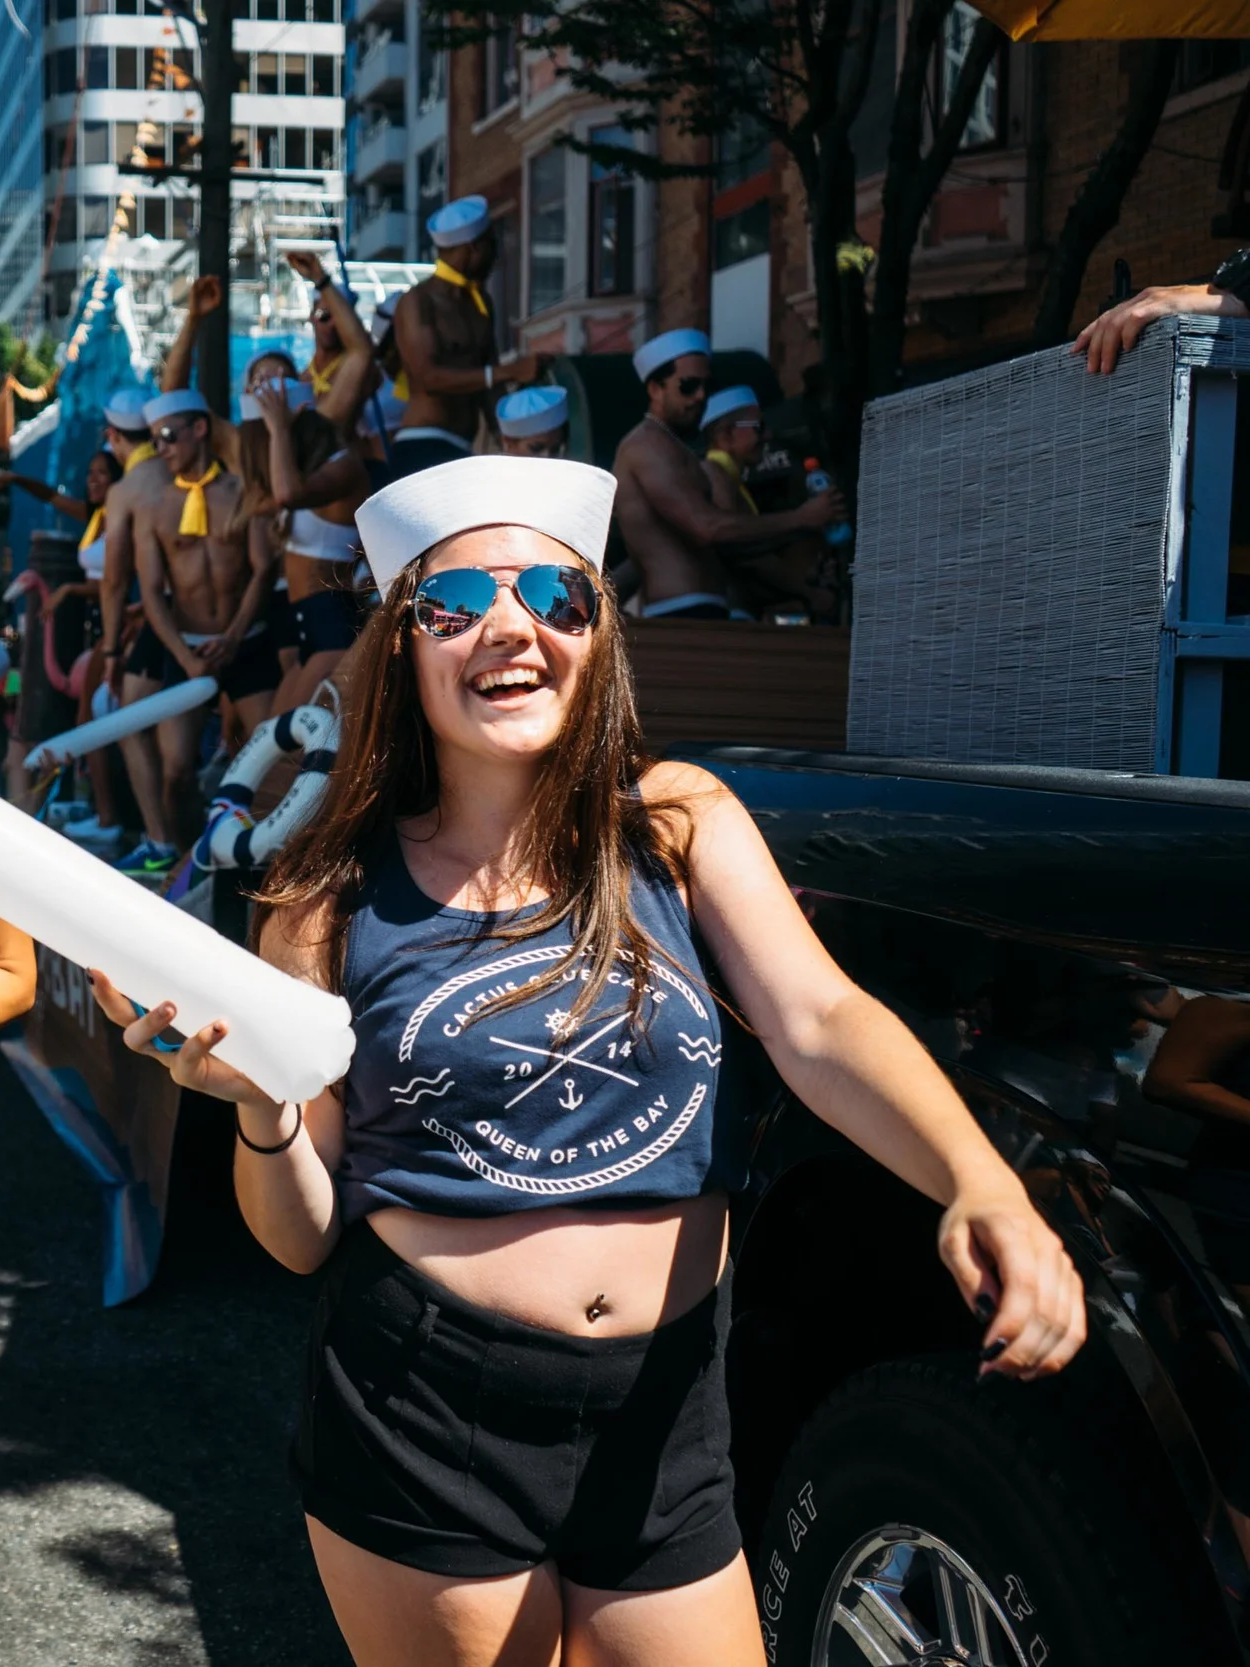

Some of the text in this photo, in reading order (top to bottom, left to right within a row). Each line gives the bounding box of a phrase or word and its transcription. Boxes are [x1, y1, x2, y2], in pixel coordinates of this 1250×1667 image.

[503, 1040, 632, 1081] 20 14
[475, 1094, 669, 1164] QUEEN OF THE BAY
[786, 1480, 818, 1553] AT
